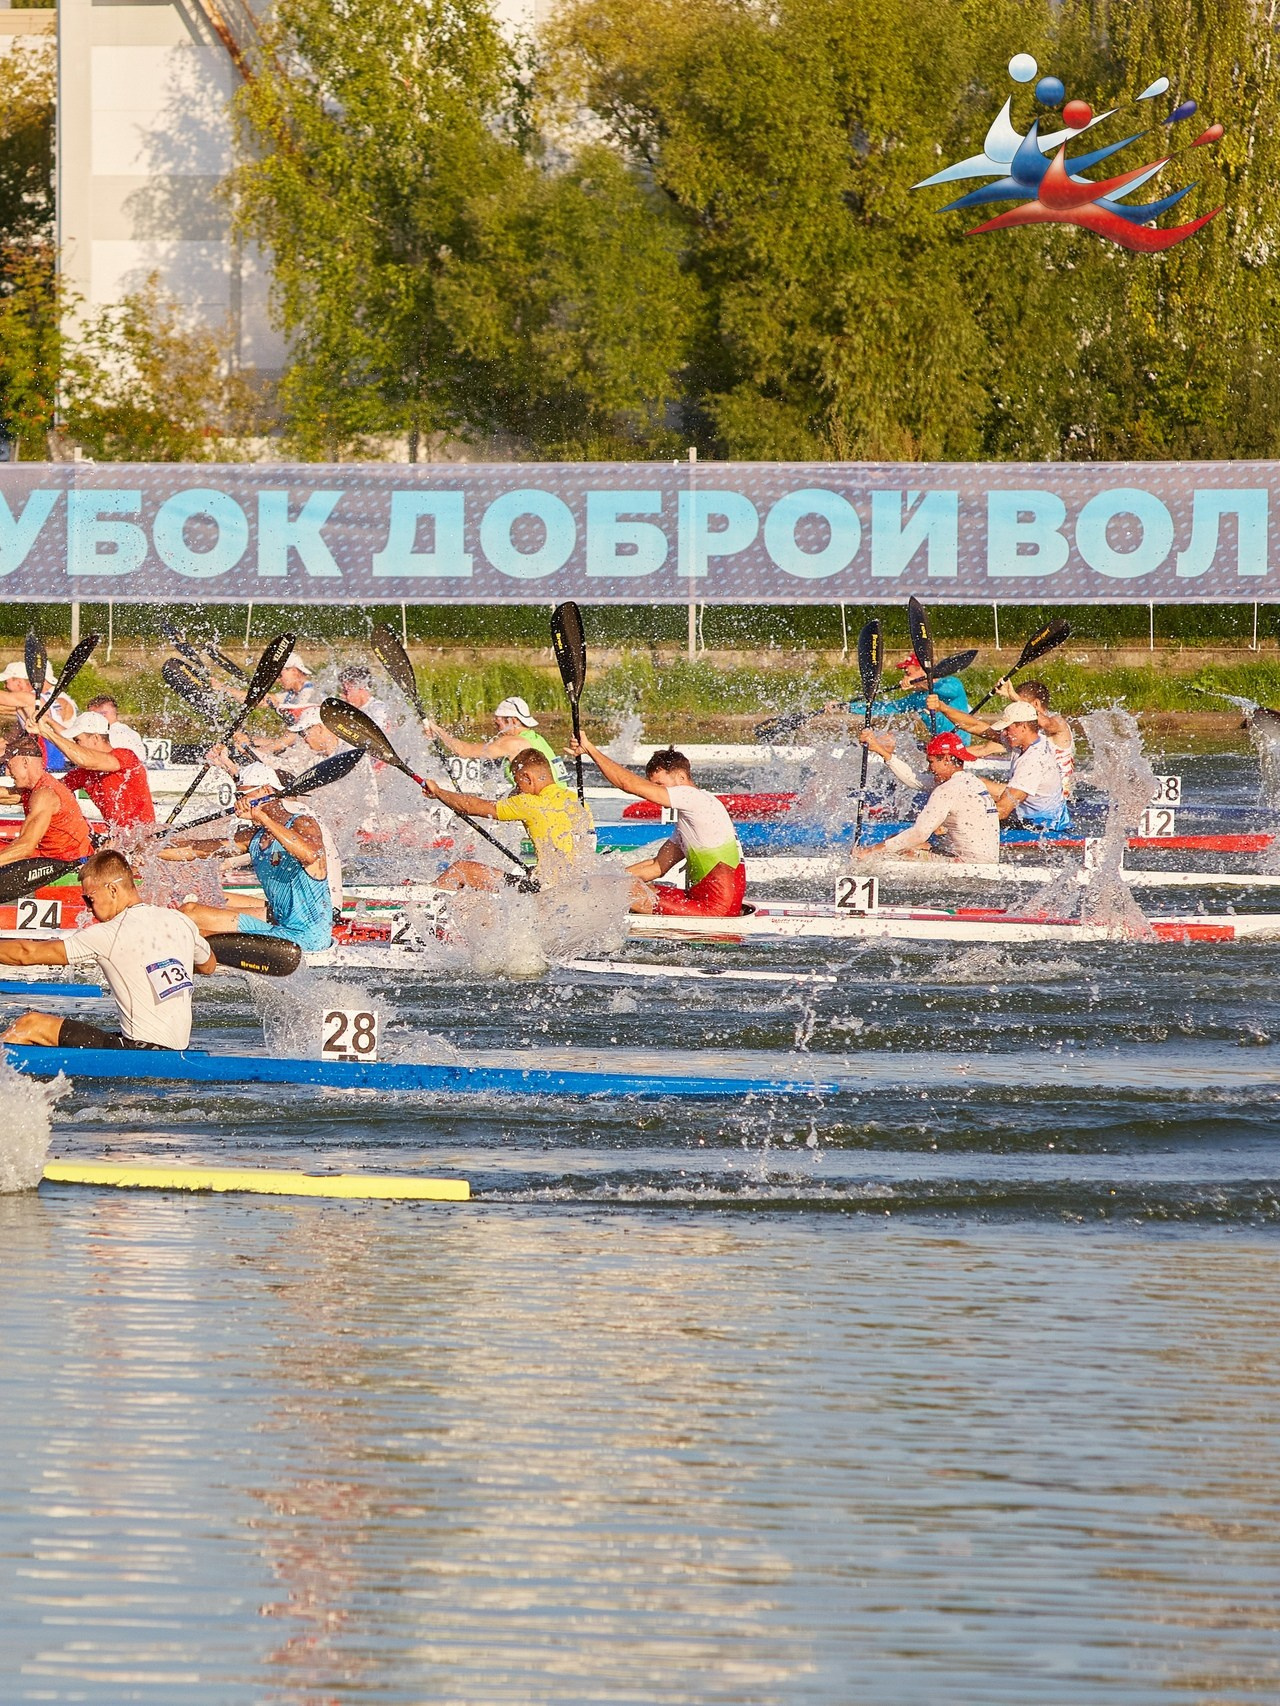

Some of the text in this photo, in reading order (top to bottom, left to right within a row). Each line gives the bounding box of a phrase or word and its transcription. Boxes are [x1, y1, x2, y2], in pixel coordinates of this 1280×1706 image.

[372, 488, 958, 579] ДОБРОЙ
[987, 488, 1268, 579] ВОЛ
[1141, 810, 1172, 836] 12
[837, 877, 874, 909] 21
[18, 900, 61, 930] 24
[323, 1011, 376, 1054] 28
